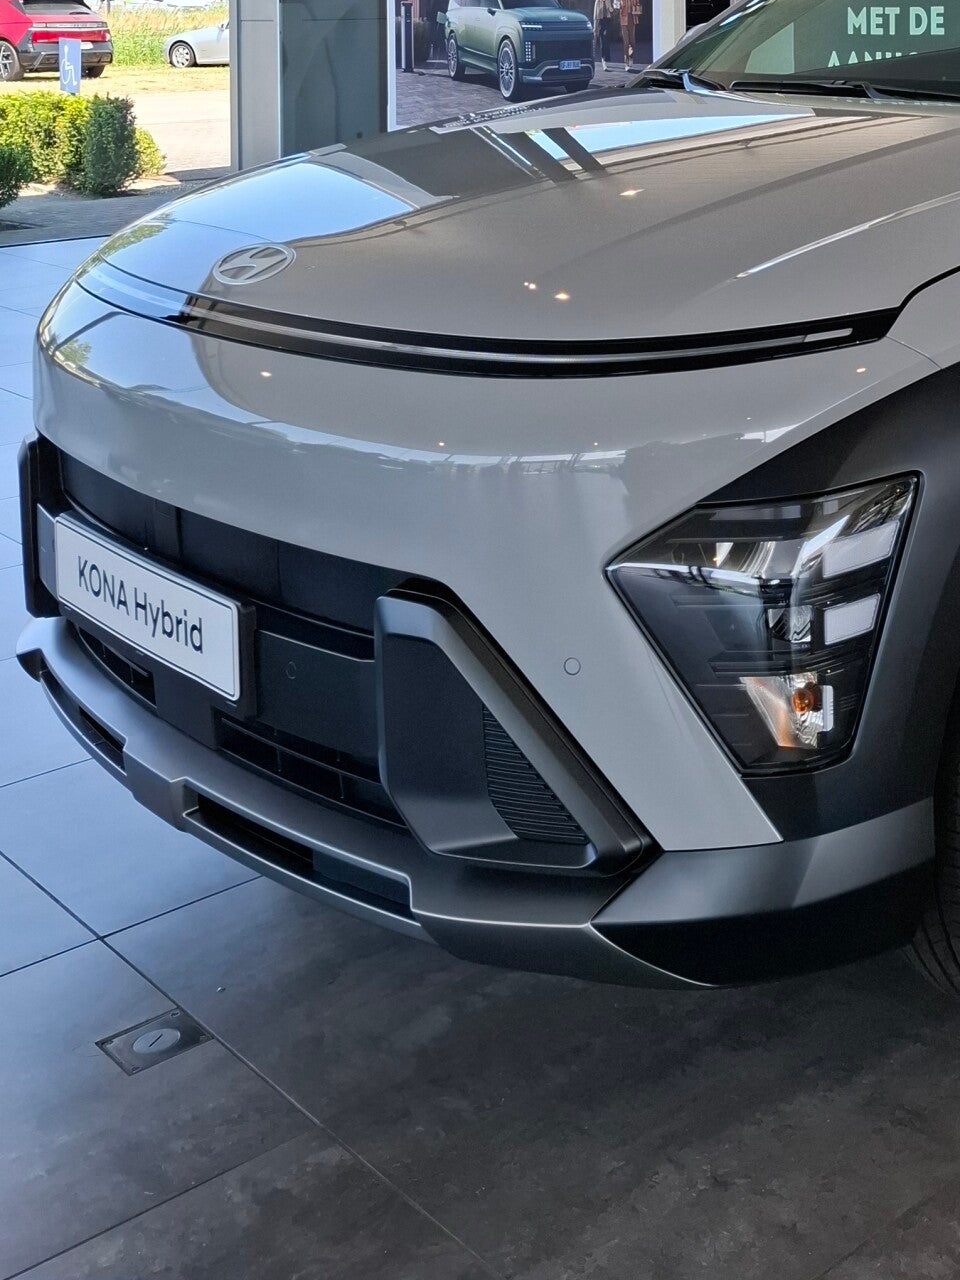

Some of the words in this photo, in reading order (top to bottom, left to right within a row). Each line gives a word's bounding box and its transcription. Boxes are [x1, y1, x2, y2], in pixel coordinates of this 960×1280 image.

[847, 6, 900, 35] MET
[909, 6, 945, 36] DE
[78, 555, 130, 616] KONA
[134, 587, 203, 654] Hybrid
